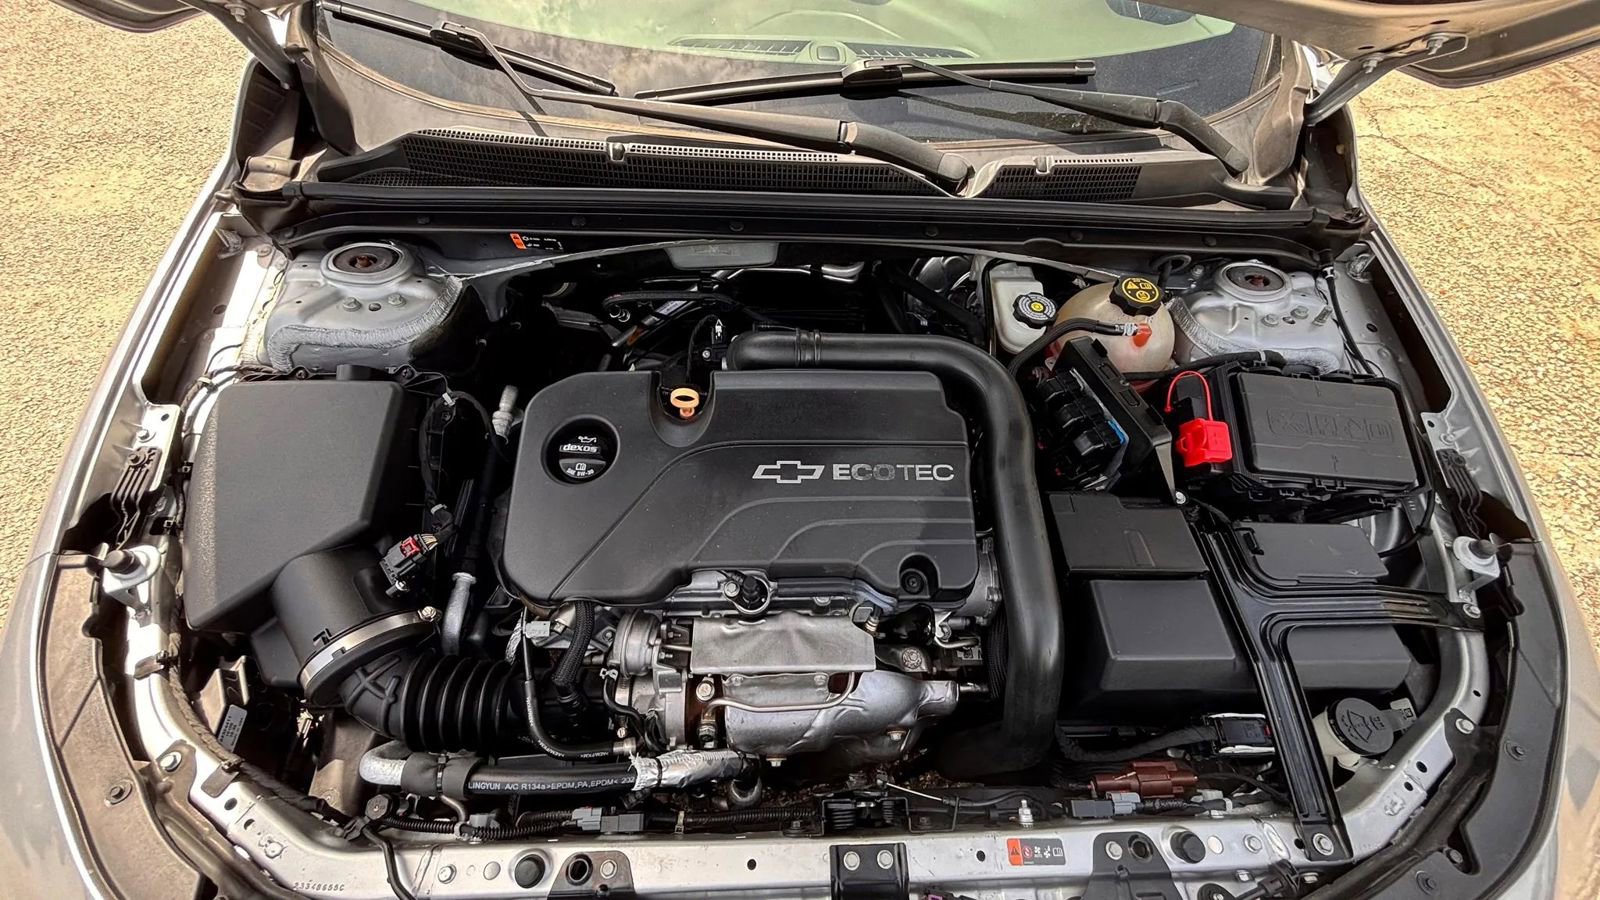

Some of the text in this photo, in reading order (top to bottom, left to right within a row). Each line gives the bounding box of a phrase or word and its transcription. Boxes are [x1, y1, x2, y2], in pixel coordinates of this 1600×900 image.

[562, 443, 598, 453] dexos
[832, 463, 954, 481] ECOTEC
[467, 781, 501, 791] LINGYUN
[504, 782, 519, 791] A/C
